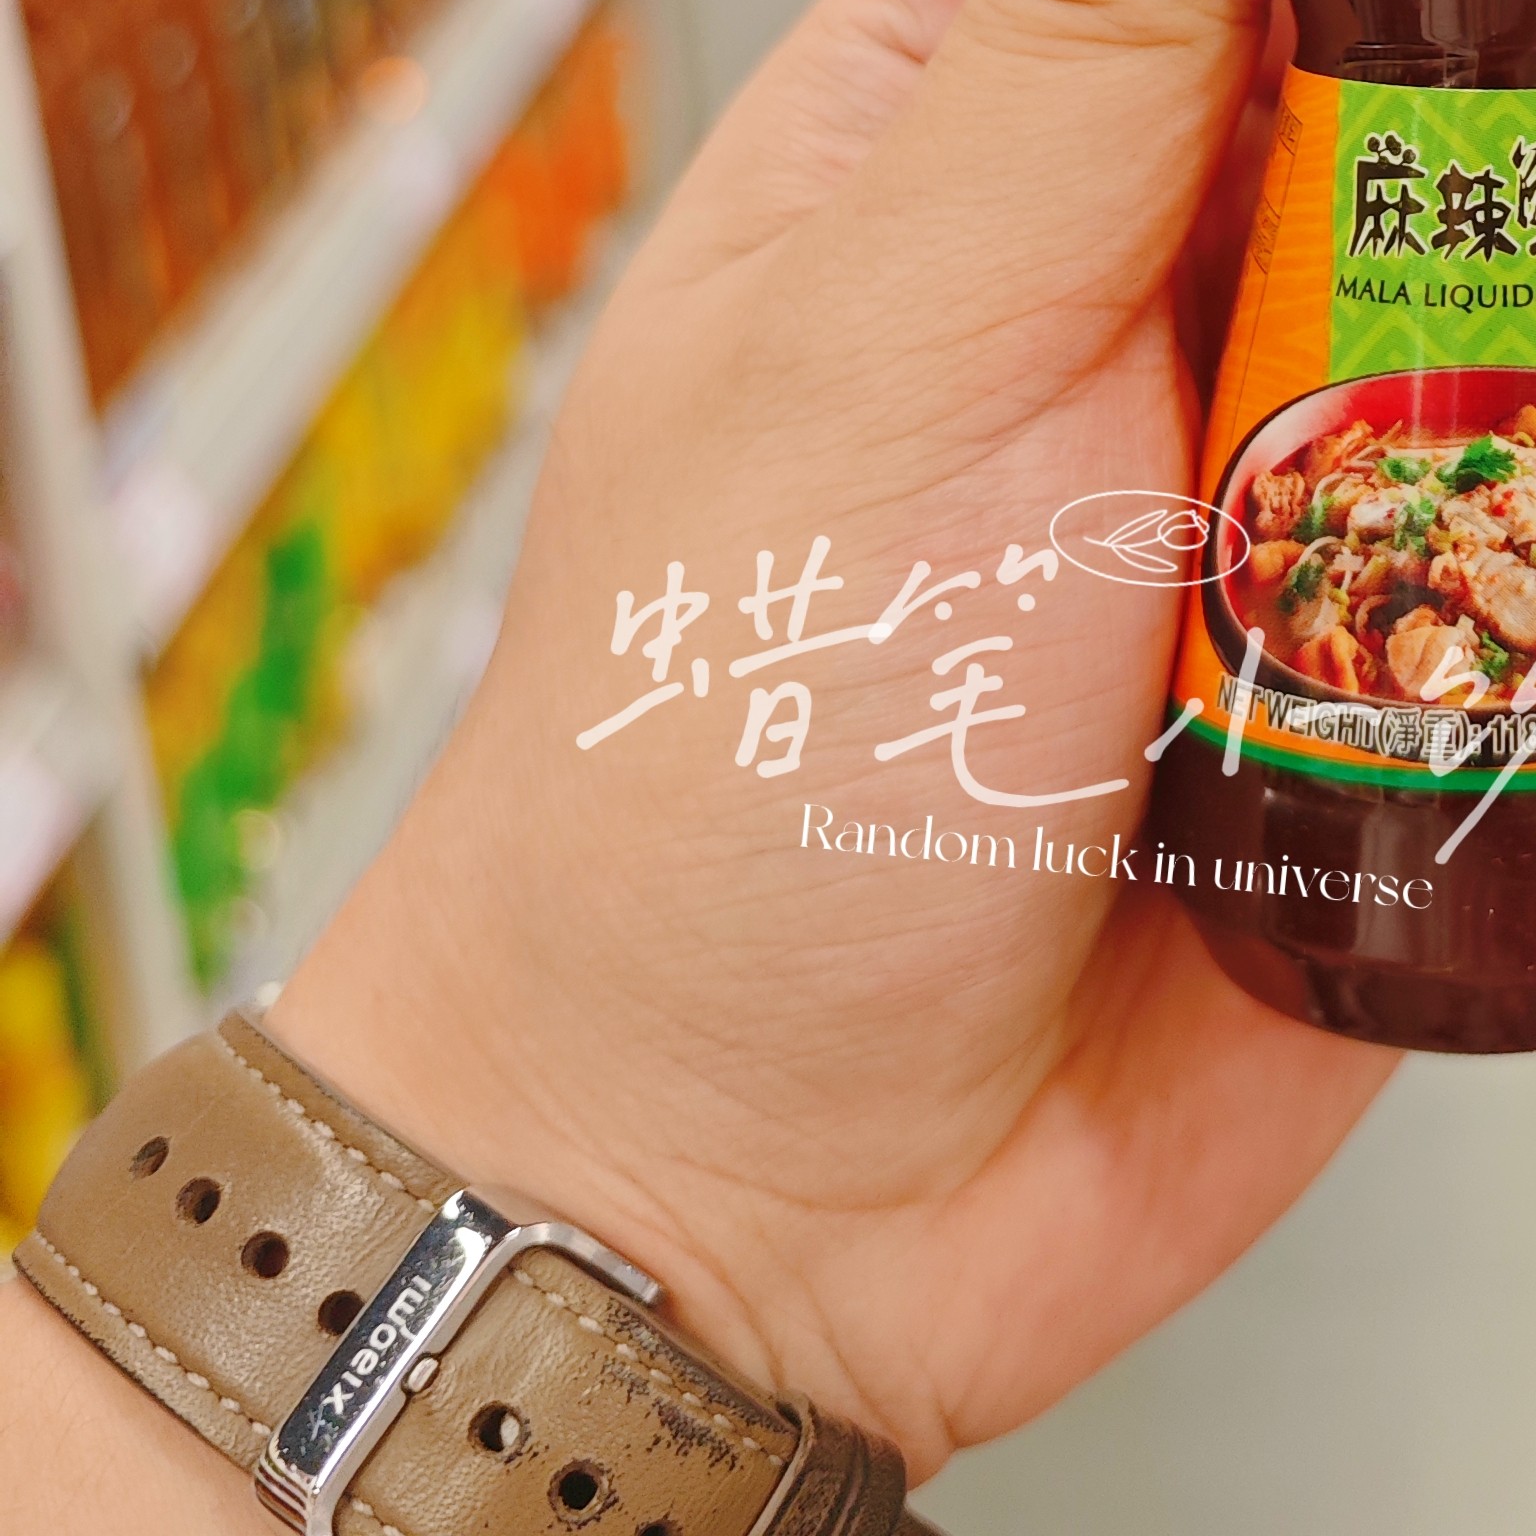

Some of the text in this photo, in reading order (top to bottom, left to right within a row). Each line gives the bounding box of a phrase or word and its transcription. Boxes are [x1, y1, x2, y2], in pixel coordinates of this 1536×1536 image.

[1335, 273, 1412, 307] MALA
[1423, 282, 1534, 313] LIQUID
[1216, 674, 1266, 721] NET
